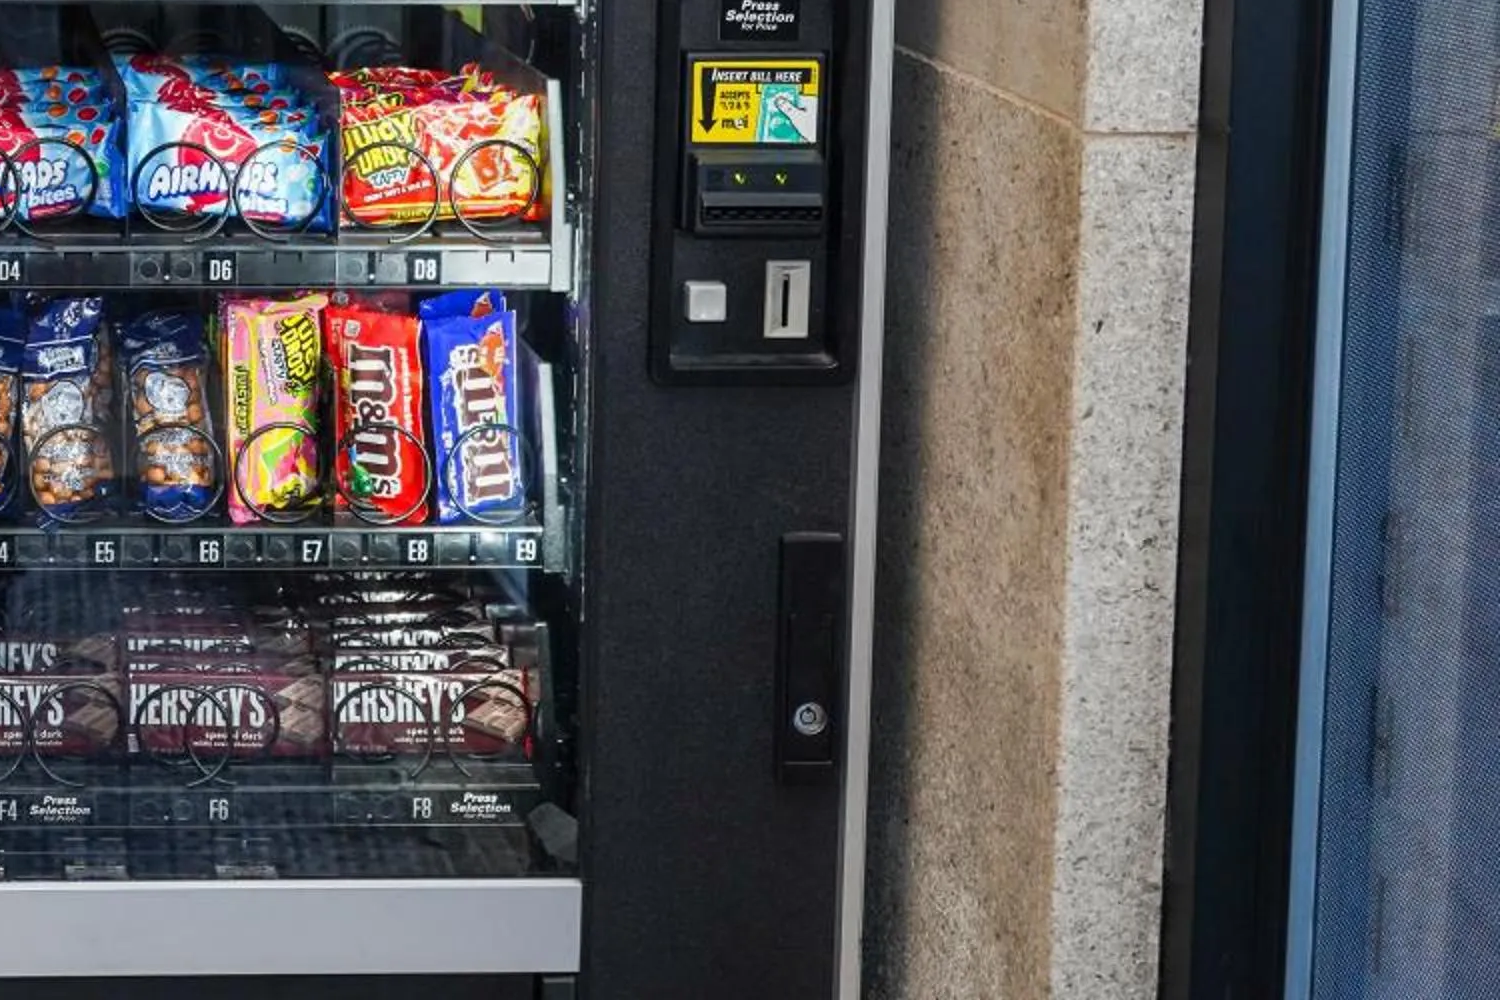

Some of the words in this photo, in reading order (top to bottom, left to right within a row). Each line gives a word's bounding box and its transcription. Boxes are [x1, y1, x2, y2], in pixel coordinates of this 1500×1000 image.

[725, 9, 795, 22] Selection
[741, 0, 780, 11] Press
[712, 68, 749, 82] INSERT
[750, 71, 771, 81] BILL
[775, 71, 803, 82] HERE
[342, 111, 415, 160] JUICY
[29, 185, 77, 207] bites
[0, 260, 20, 281] D4
[209, 259, 232, 281] D6
[414, 258, 437, 281] D8
[281, 327, 306, 379] DROP
[95, 541, 115, 563] E5
[199, 540, 219, 563] E6
[302, 539, 323, 563] E7
[408, 539, 428, 562] E8
[515, 538, 537, 561] E9
[448, 726, 465, 735] ark
[43, 795, 77, 805] Press
[450, 802, 511, 813] Selection
[463, 791, 498, 802] Press
[29, 804, 91, 815] Selection
[209, 798, 229, 821] F6
[413, 797, 432, 819] F8
